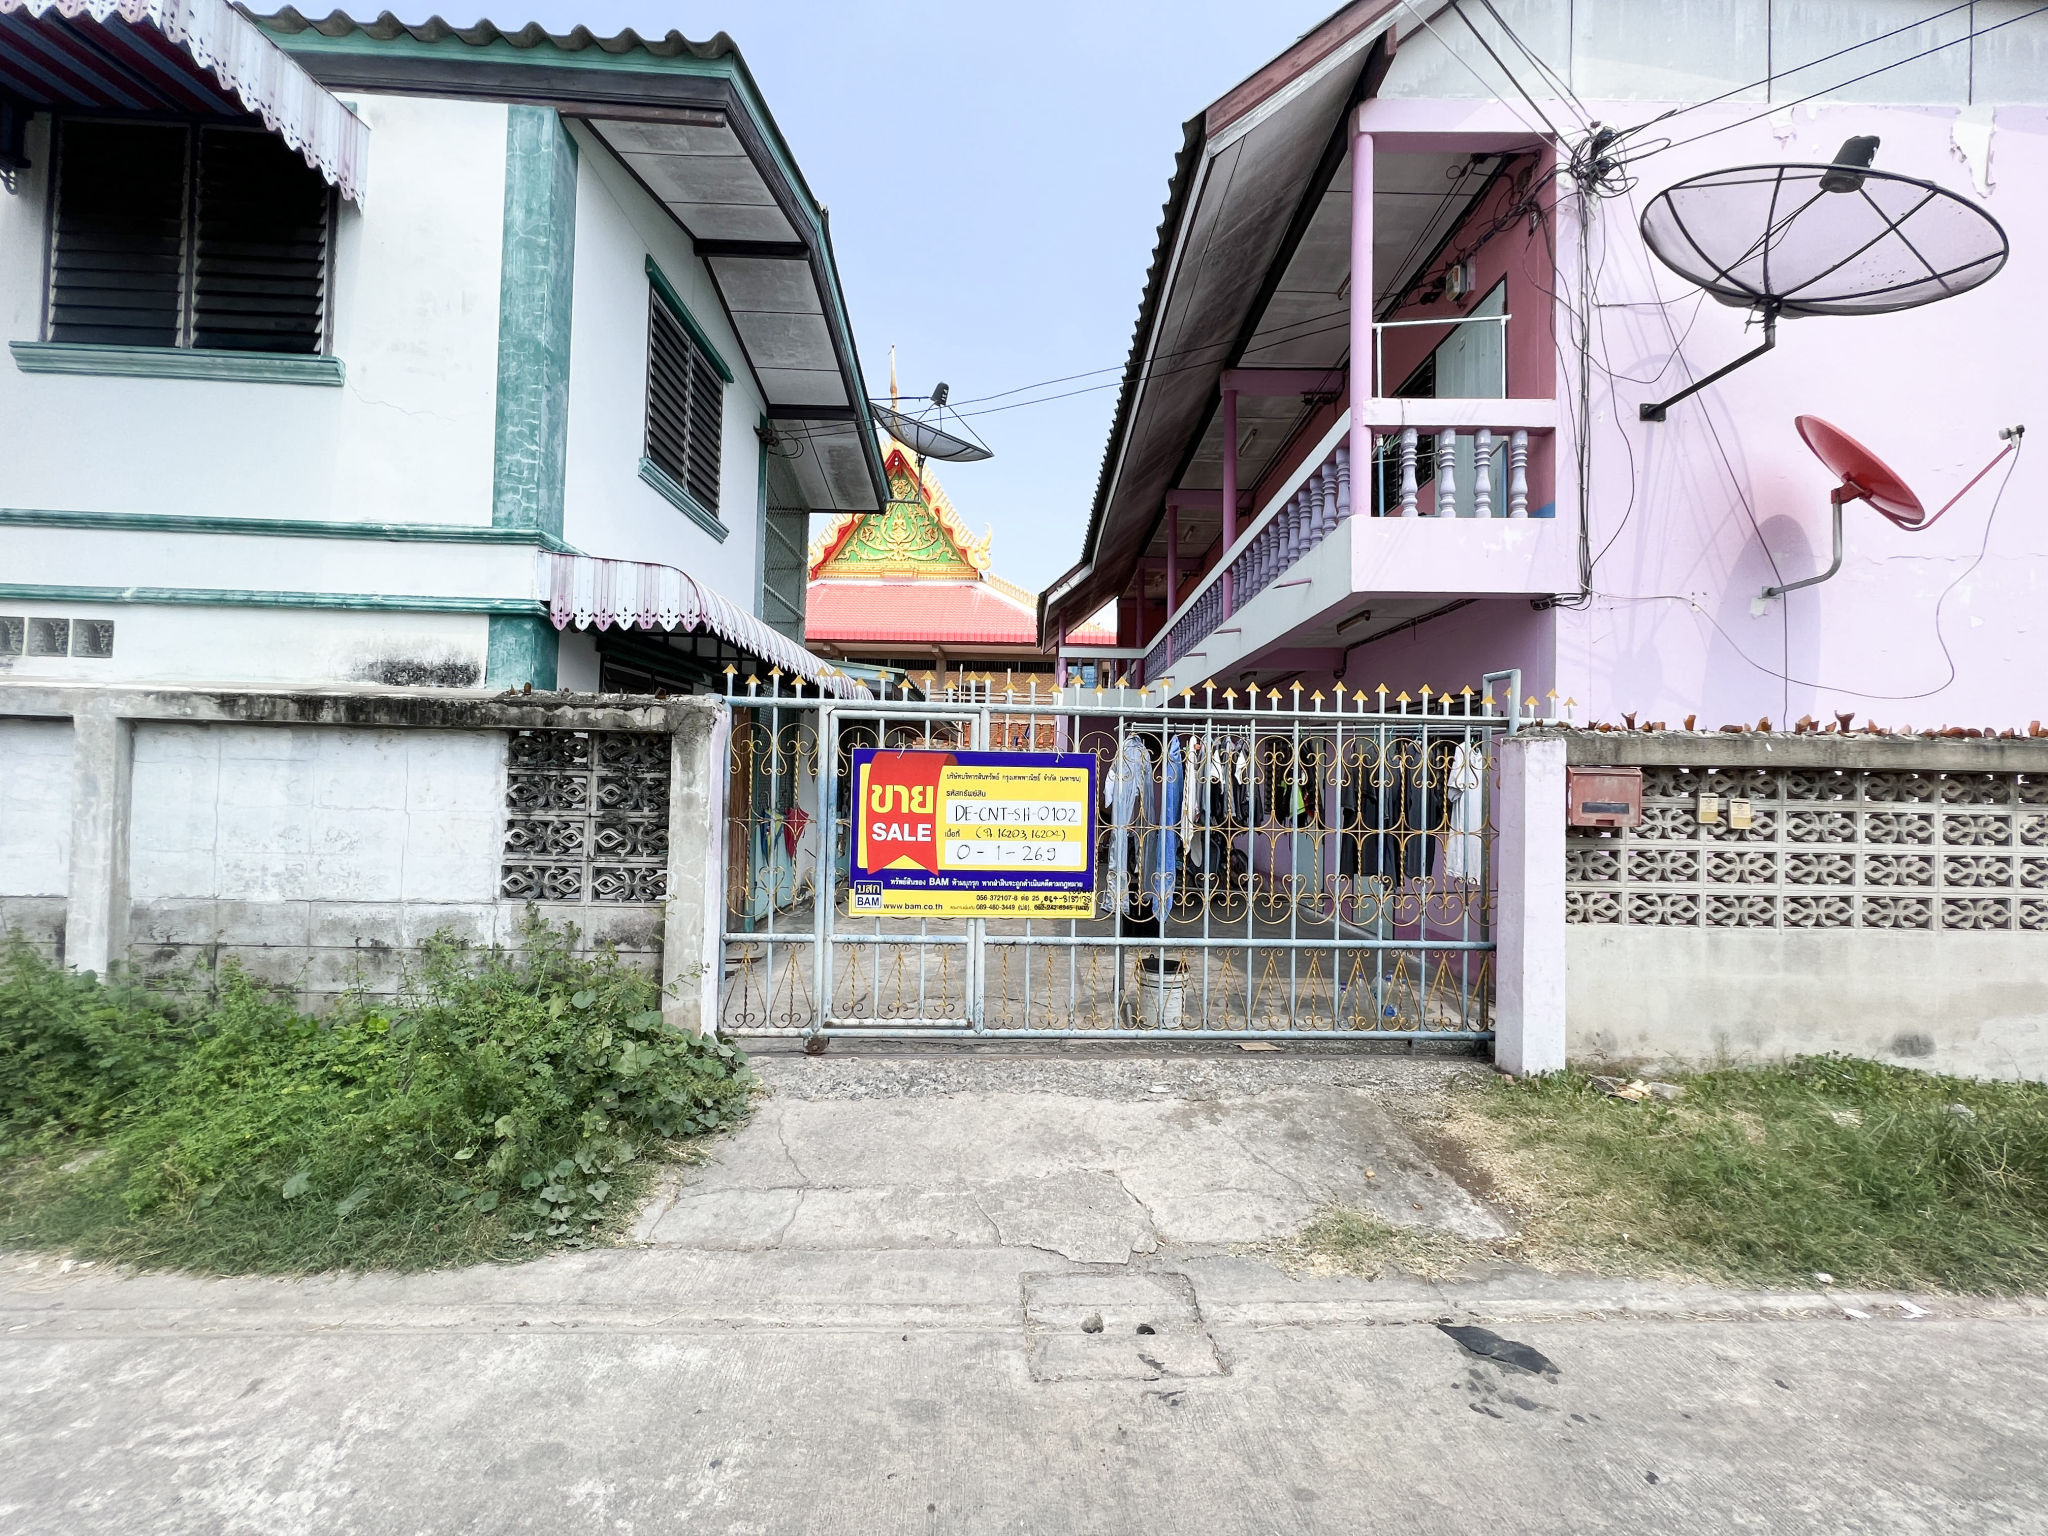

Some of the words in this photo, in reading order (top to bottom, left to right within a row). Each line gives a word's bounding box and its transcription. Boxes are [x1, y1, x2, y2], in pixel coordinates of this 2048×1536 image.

[871, 784, 934, 814] ขาย
[871, 822, 932, 842] SALE
[944, 828, 960, 838] เนื้อที่
[928, 877, 949, 887] BAM
[857, 884, 880, 894] บสก
[857, 897, 879, 906] BAM
[883, 902, 943, 910] www.bam.co.th
